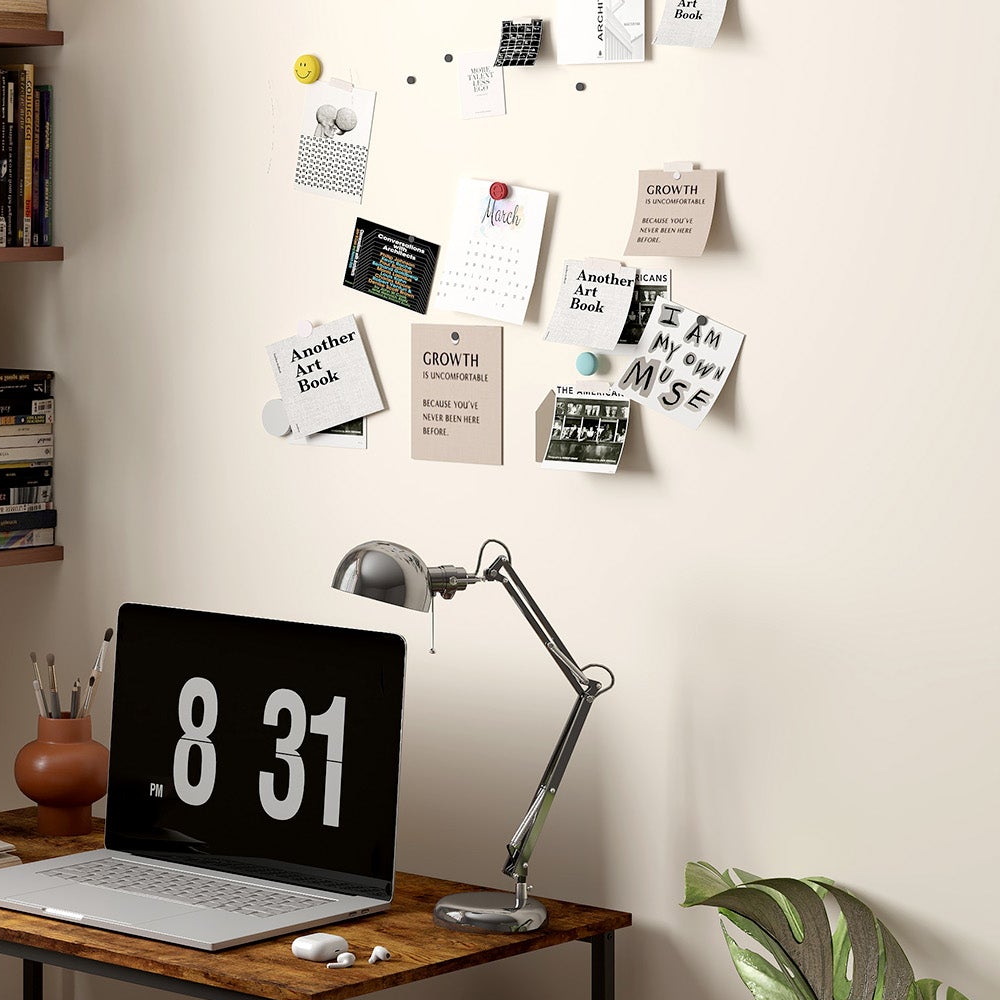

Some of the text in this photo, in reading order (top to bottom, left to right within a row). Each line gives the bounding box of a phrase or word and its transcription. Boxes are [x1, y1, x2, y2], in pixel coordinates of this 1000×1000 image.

[677, 0, 697, 8] Art
[674, 9, 703, 20] Book
[646, 185, 698, 195] GROWTH
[481, 196, 521, 227] March
[377, 234, 425, 254] Conversations
[382, 245, 416, 261] Architects
[576, 269, 634, 288] Another
[635, 274, 668, 282] RICANS
[574, 284, 598, 298] Art
[570, 297, 604, 313] Book
[661, 306, 721, 348] I AM
[290, 331, 356, 363] Another
[423, 351, 479, 367] GROWTH
[652, 333, 726, 380] MY OWN
[295, 358, 323, 378] Art
[298, 370, 340, 393] Book
[431, 372, 489, 382] UNCOMFORTABLE
[623, 360, 711, 409] MUSE
[557, 386, 573, 394] THE
[423, 399, 478, 410] BECAUSE YOU'VE
[423, 413, 480, 424] NEVER BEEN HERE
[423, 427, 449, 436] BEFORE.
[173, 676, 346, 827] 8 31
[150, 783, 163, 798] PM
